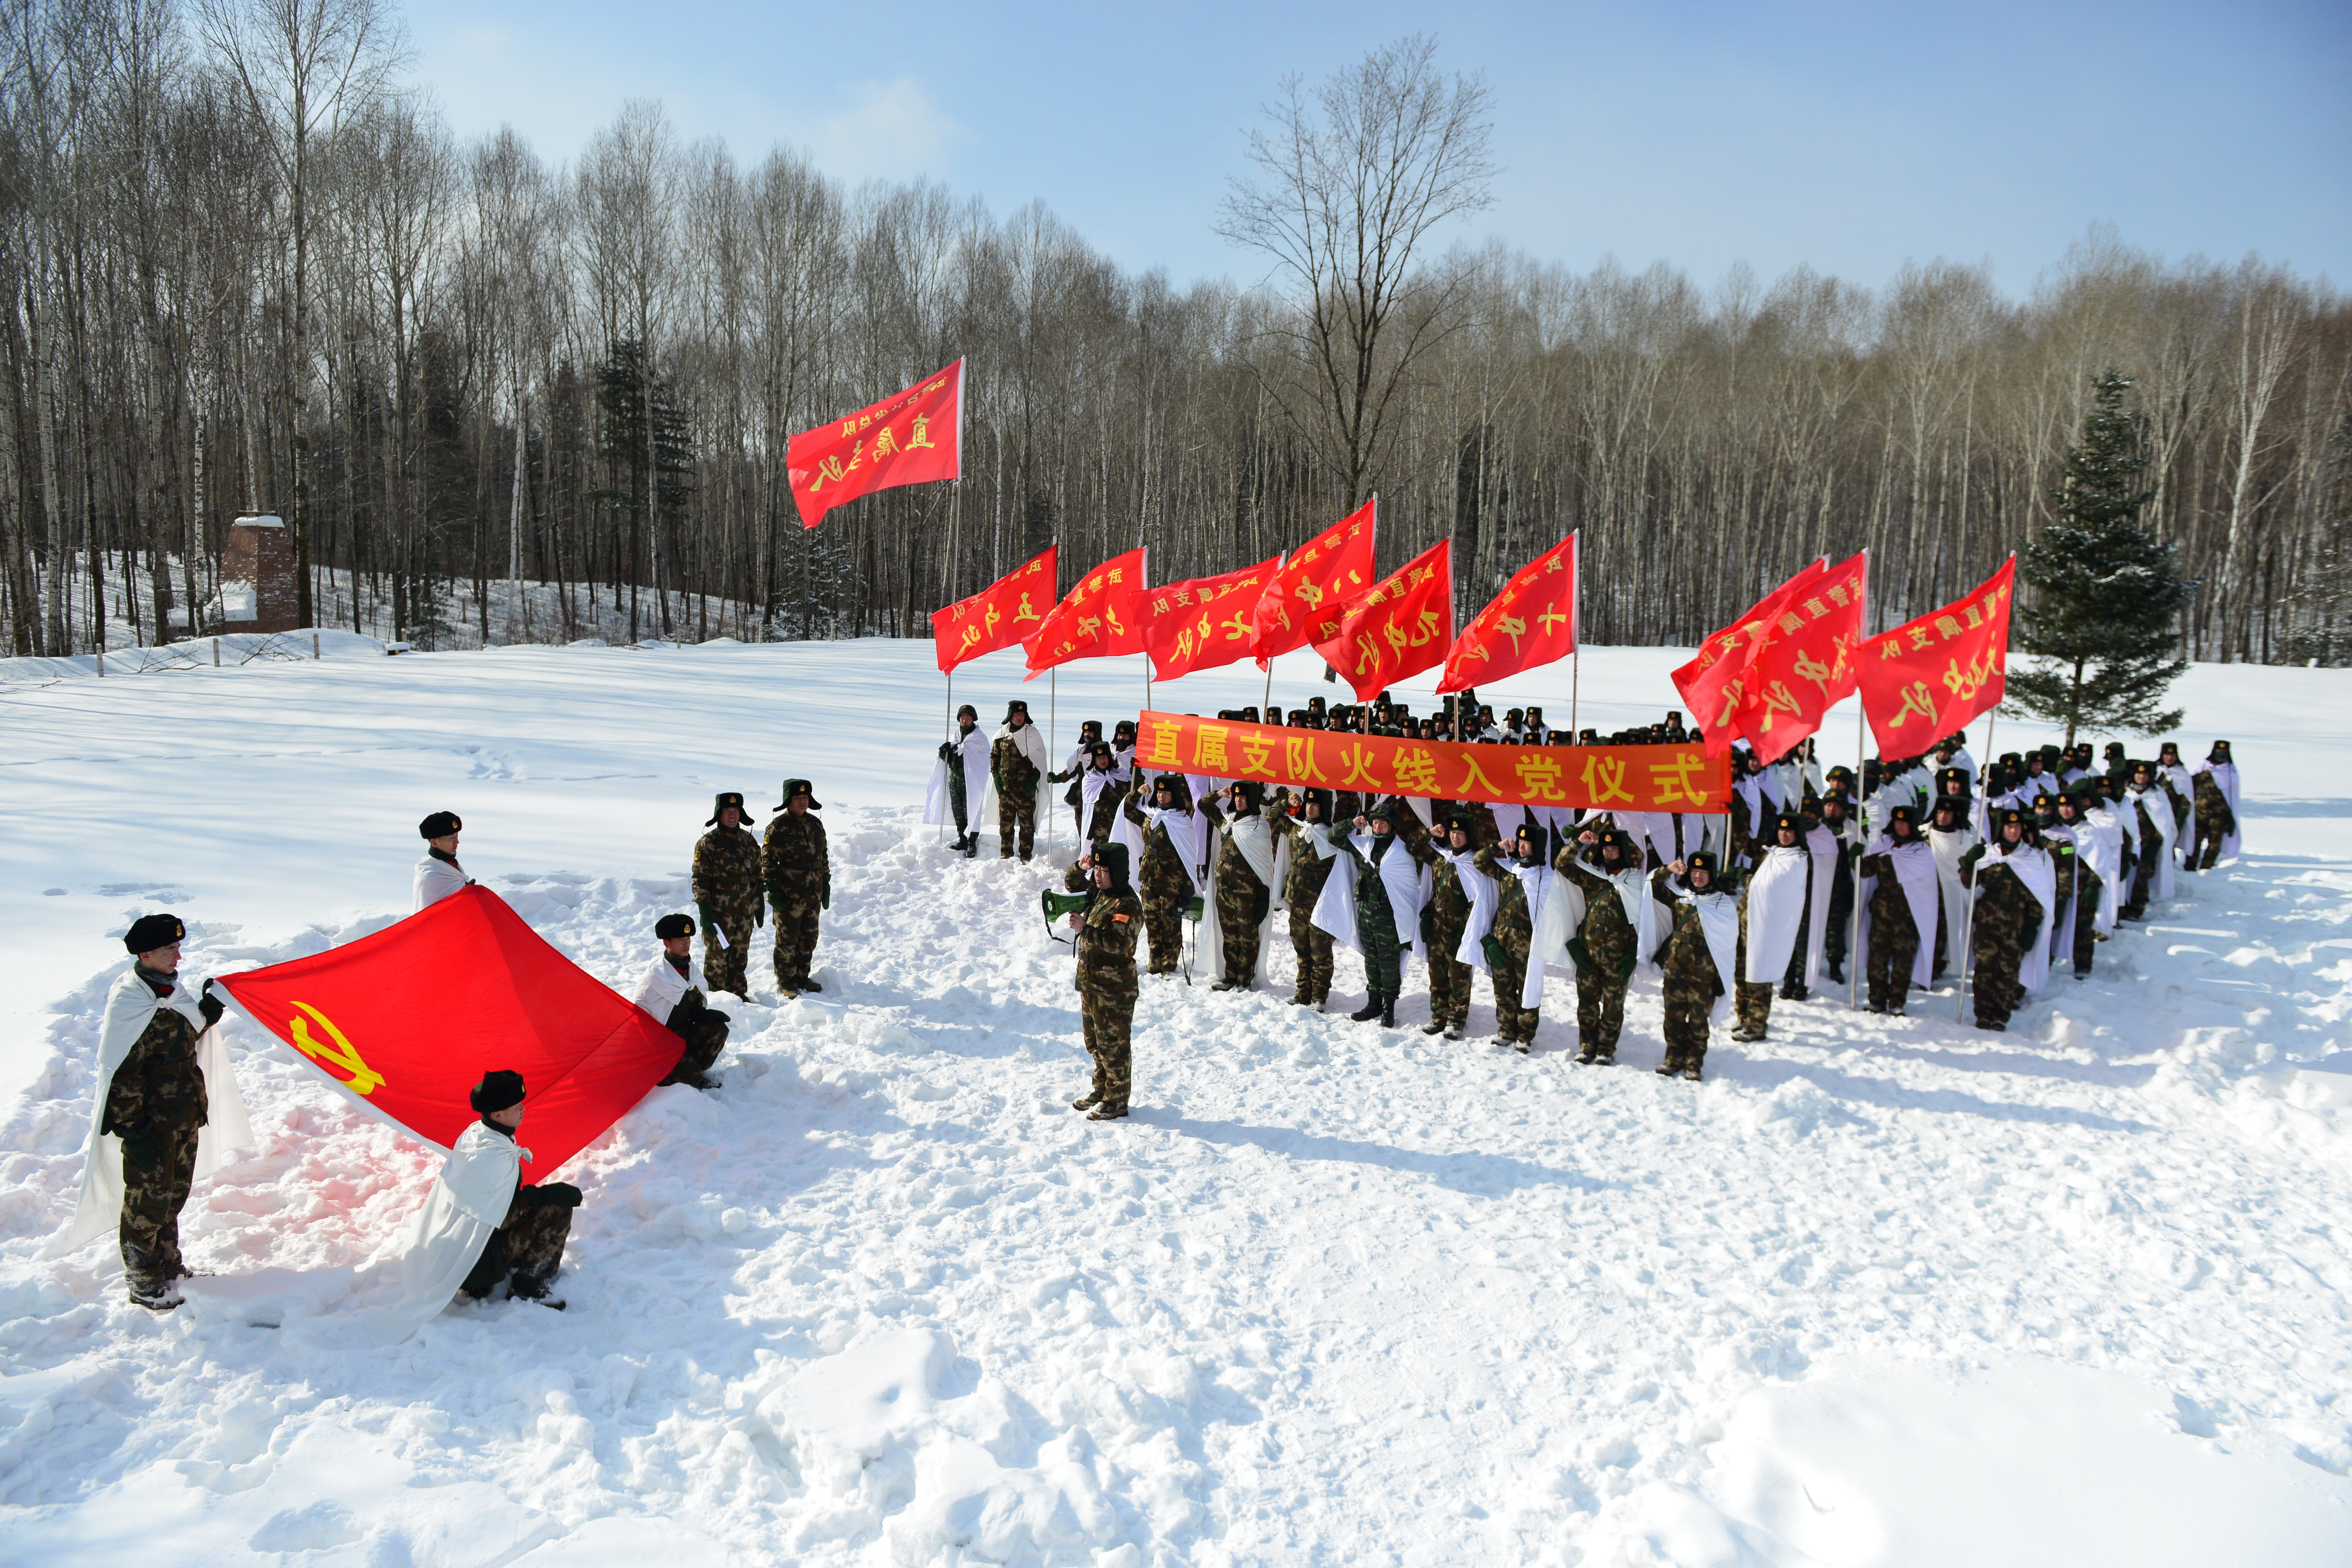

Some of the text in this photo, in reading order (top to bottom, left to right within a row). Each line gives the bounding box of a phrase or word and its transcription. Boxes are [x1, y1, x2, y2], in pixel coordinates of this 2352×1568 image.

[1148, 720, 1707, 806] 直属支队火线入党仪式
